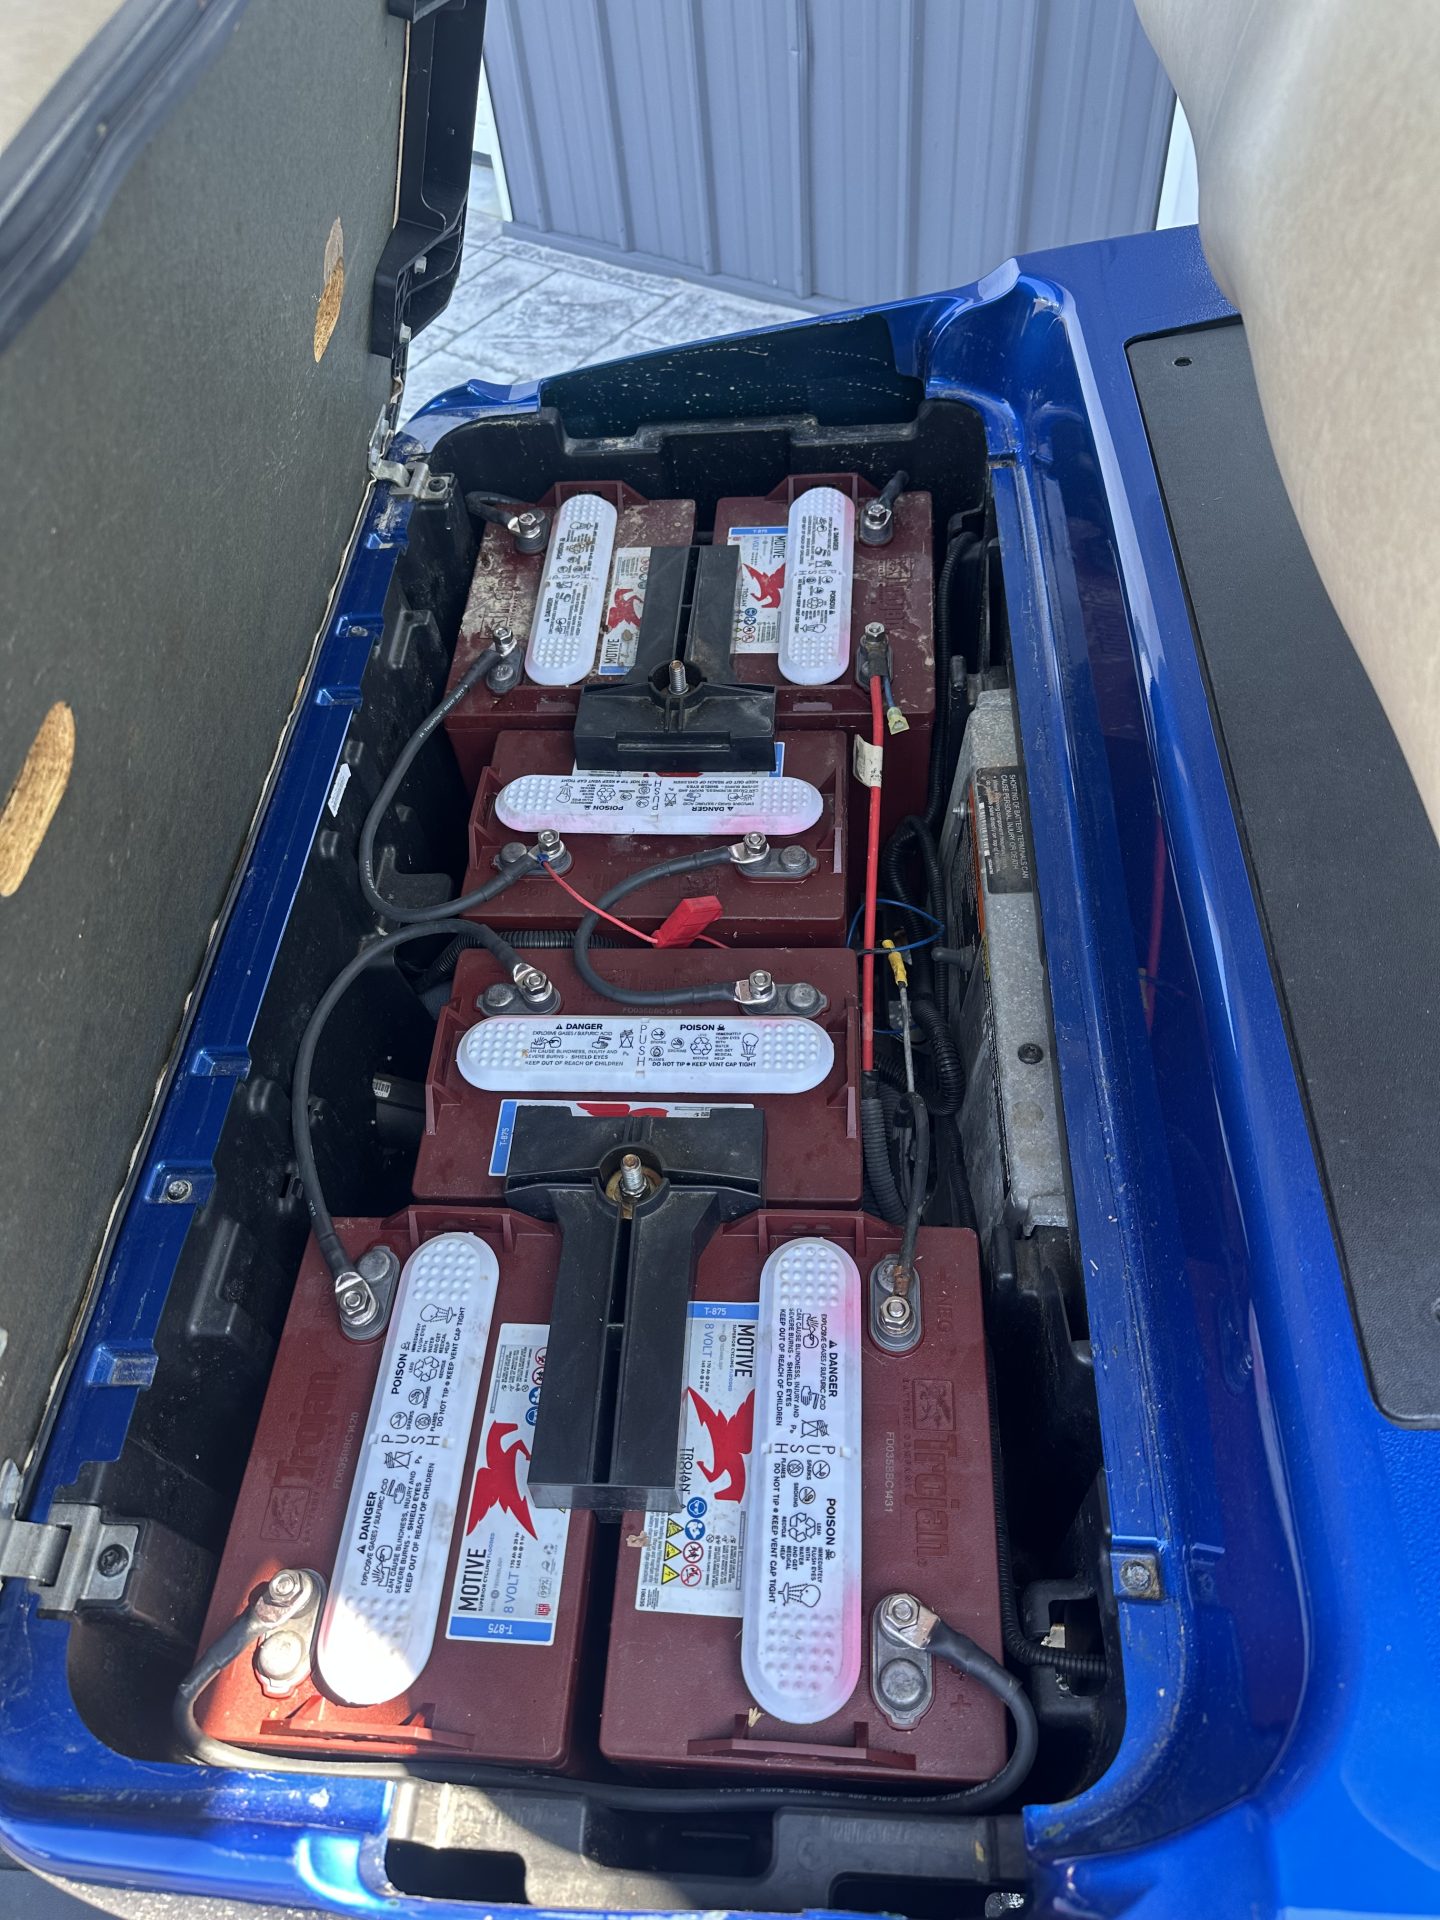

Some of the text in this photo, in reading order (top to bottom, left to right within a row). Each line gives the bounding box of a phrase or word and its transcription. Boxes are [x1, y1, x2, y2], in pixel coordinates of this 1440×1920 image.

[773, 535, 786, 558] MOTIVE
[604, 639, 619, 663] MOTIVE
[1000, 774, 1008, 792] CAUSE
[1003, 792, 1012, 820] PERSONAL
[1007, 821, 1015, 840] INJURY
[1008, 774, 1029, 878] SHORTING OF BATTERY TERMINALS CAN
[456, 1306, 465, 1325] TIGHT
[703, 1307, 726, 1315] T-875
[411, 1323, 420, 1351] IMMEDIATELY
[438, 1333, 446, 1352] MEDICAL
[453, 1327, 461, 1340] CAP
[702, 1331, 713, 1357] VOLT
[449, 1343, 458, 1359] VENT
[734, 1324, 755, 1377] MOTIVE
[778, 1343, 784, 1352] OF
[391, 1353, 407, 1394] POISON
[438, 1360, 446, 1378] RECYCLE
[446, 1361, 454, 1378] KEEP
[828, 1352, 838, 1397] DANGER
[777, 1379, 783, 1388] OF
[422, 1386, 431, 1408] SMOKING
[775, 1390, 783, 1425] CHILDREN
[406, 1410, 414, 1429] SPARKS
[430, 1412, 438, 1431] FLAMES
[436, 1416, 443, 1426] DO
[380, 1434, 440, 1444] PUSH
[774, 1443, 835, 1454] PUSH
[681, 1447, 693, 1492] TROJAN
[774, 1463, 780, 1473] DO
[904, 1436, 959, 1557] Trojan
[358, 1491, 376, 1539] DANGER
[825, 1498, 835, 1544] POISON
[360, 1478, 388, 1585] EXPLOSIVE GASES SULFURIC ACID
[386, 1471, 416, 1592] CAN CAUSE BLINDNESS, INJURY AND
[394, 1482, 421, 1593] SEVERE BURNS SHIELD EYES
[403, 1463, 434, 1592] KEEP OUT OF REACH OF CHILDREN
[456, 1547, 488, 1611] MOTIVE
[477, 1532, 495, 1611] SUPERIOR CYCLING FLOODED
[503, 1571, 520, 1603] VOLT
[502, 1605, 513, 1613] 8
[487, 1623, 513, 1633] T-875
